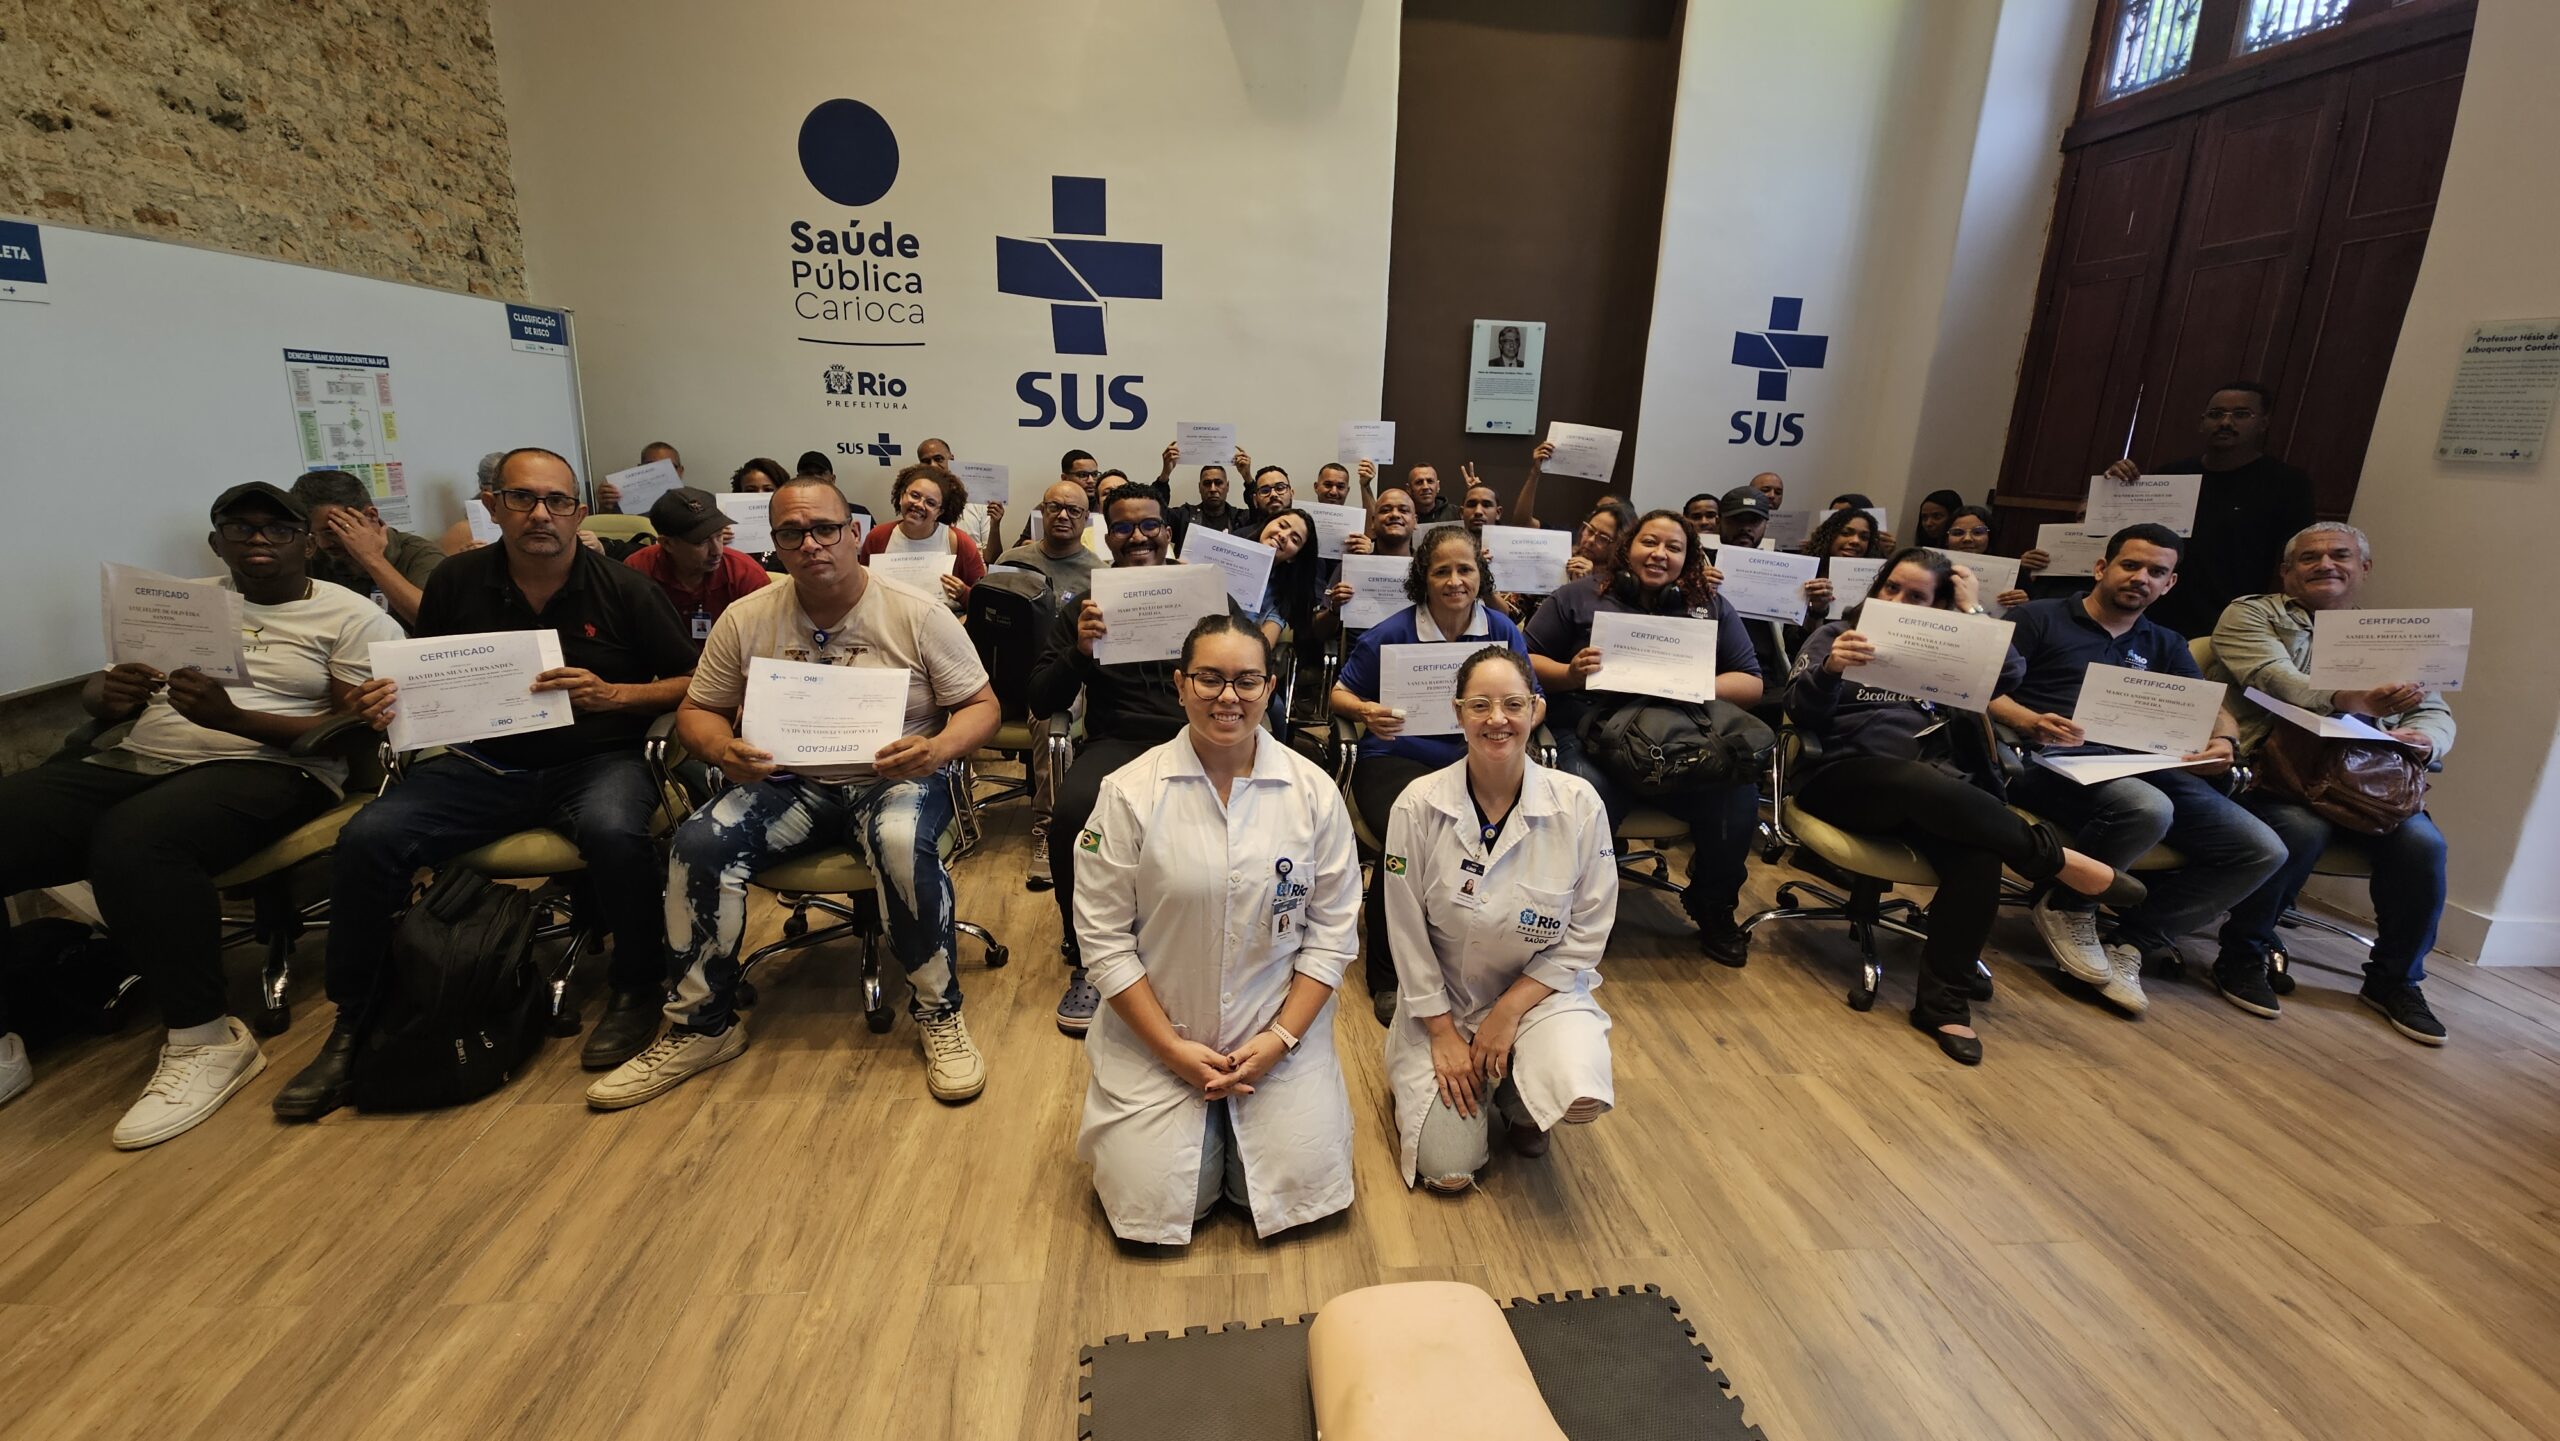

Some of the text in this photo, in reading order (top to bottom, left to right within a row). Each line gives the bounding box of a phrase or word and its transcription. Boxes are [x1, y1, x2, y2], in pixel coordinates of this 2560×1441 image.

[790, 219, 920, 259] Saúde
[0, 245, 31, 260] ETA
[791, 259, 923, 294] Pública
[795, 291, 925, 324] Carioca
[513, 313, 556, 327] CLASSIFICAÇÃO
[524, 326, 550, 337] DE RISCO
[2476, 332, 2559, 343] Professor Hésio de
[2466, 343, 2560, 354] Albuquerque Cordeir
[287, 351, 313, 361] DENGUE:
[313, 353, 335, 362] MANEJO
[336, 355, 344, 363] DO
[344, 356, 368, 365] PACIENTE
[368, 357, 375, 365] NA
[857, 371, 907, 397] Rio
[826, 400, 908, 410] PREFEITURA
[1016, 371, 1148, 431] SUS
[1728, 410, 1805, 447] SUS
[836, 442, 864, 455] SUS
[2462, 447, 2478, 456] Rio
[1211, 545, 1249, 560] CERTIFICADO
[1748, 557, 1790, 568] CERTIFICADO
[135, 587, 190, 600] CERTIFICADO
[1123, 588, 1173, 599] CERTIFICADO
[1898, 617, 1959, 633] CERTIFICADO
[2358, 617, 2431, 625] CERTIFICADO
[1630, 631, 1681, 644] CERTIFICADO
[1888, 631, 1915, 641] NATASHA
[420, 645, 495, 662] CERTIFICADO
[408, 662, 514, 681] DAVID DA SILVA FERNANDES
[1412, 662, 1463, 672] CERTIFICADO
[1926, 685, 1939, 693] RIO
[2123, 676, 2186, 692] CERTIFICADO
[1856, 688, 1897, 702] Escola
[2106, 689, 2129, 698] MARCO
[2134, 699, 2162, 708] PEREIRA
[497, 718, 513, 726] RIO
[797, 744, 860, 753] CERTIFICADO
[2155, 743, 2168, 751] RIO
[1599, 849, 1615, 859] SUS
[1291, 884, 1308, 897] Rio
[1537, 915, 1561, 929] Rio
[1524, 936, 1549, 944] SAÚDE
